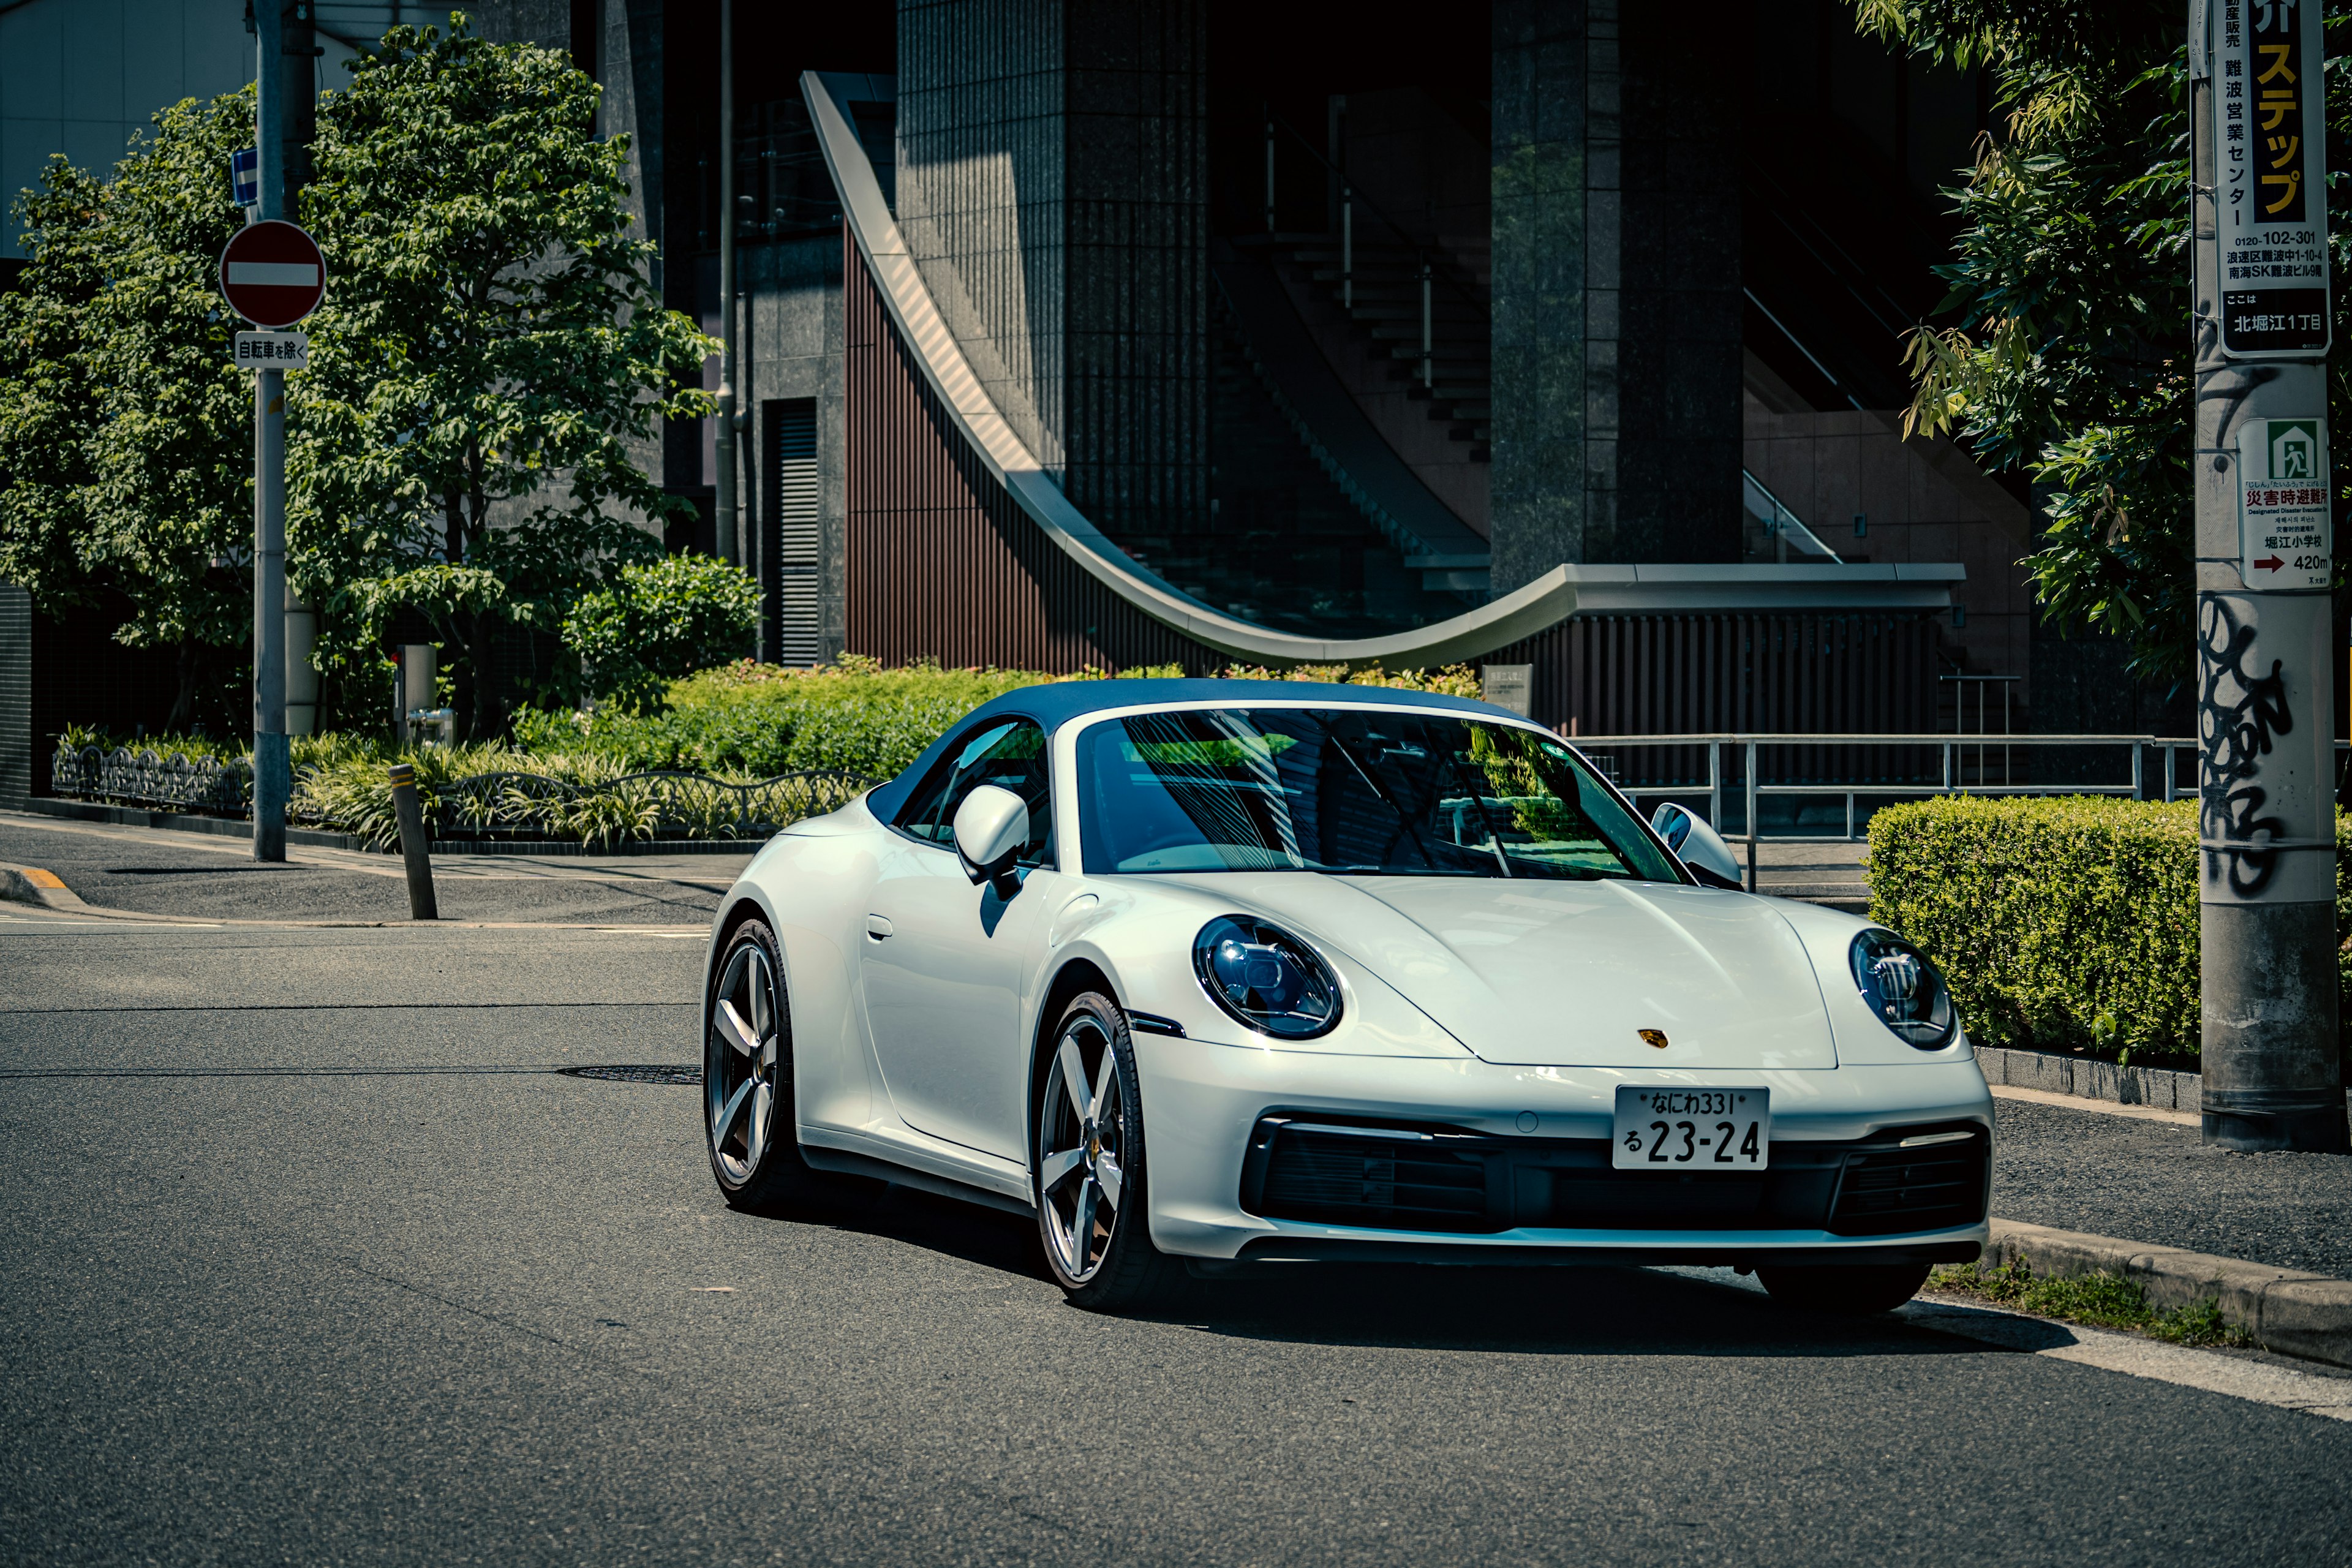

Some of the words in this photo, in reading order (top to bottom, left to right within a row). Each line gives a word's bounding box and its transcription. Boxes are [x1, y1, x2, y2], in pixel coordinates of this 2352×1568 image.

[2257, 44, 2301, 214] ステップ
[2225, 59, 2244, 226] 難波営業センター
[2235, 231, 2315, 246] 0120-102-301
[2227, 249, 2323, 264] 浪速区難波中1-10-4
[2229, 264, 2322, 279] 南海SK難波ビル9階
[2227, 295, 2256, 304] ここは
[2234, 314, 2321, 333] 北堀江1丁目
[239, 340, 304, 360] 自転車を除く
[2246, 488, 2328, 507] 災害時避難所
[2264, 534, 2322, 549] 堀江小学校
[2294, 555, 2328, 570] 420m
[1624, 1130, 1642, 1152] る
[1648, 1120, 1760, 1163] 23-24
